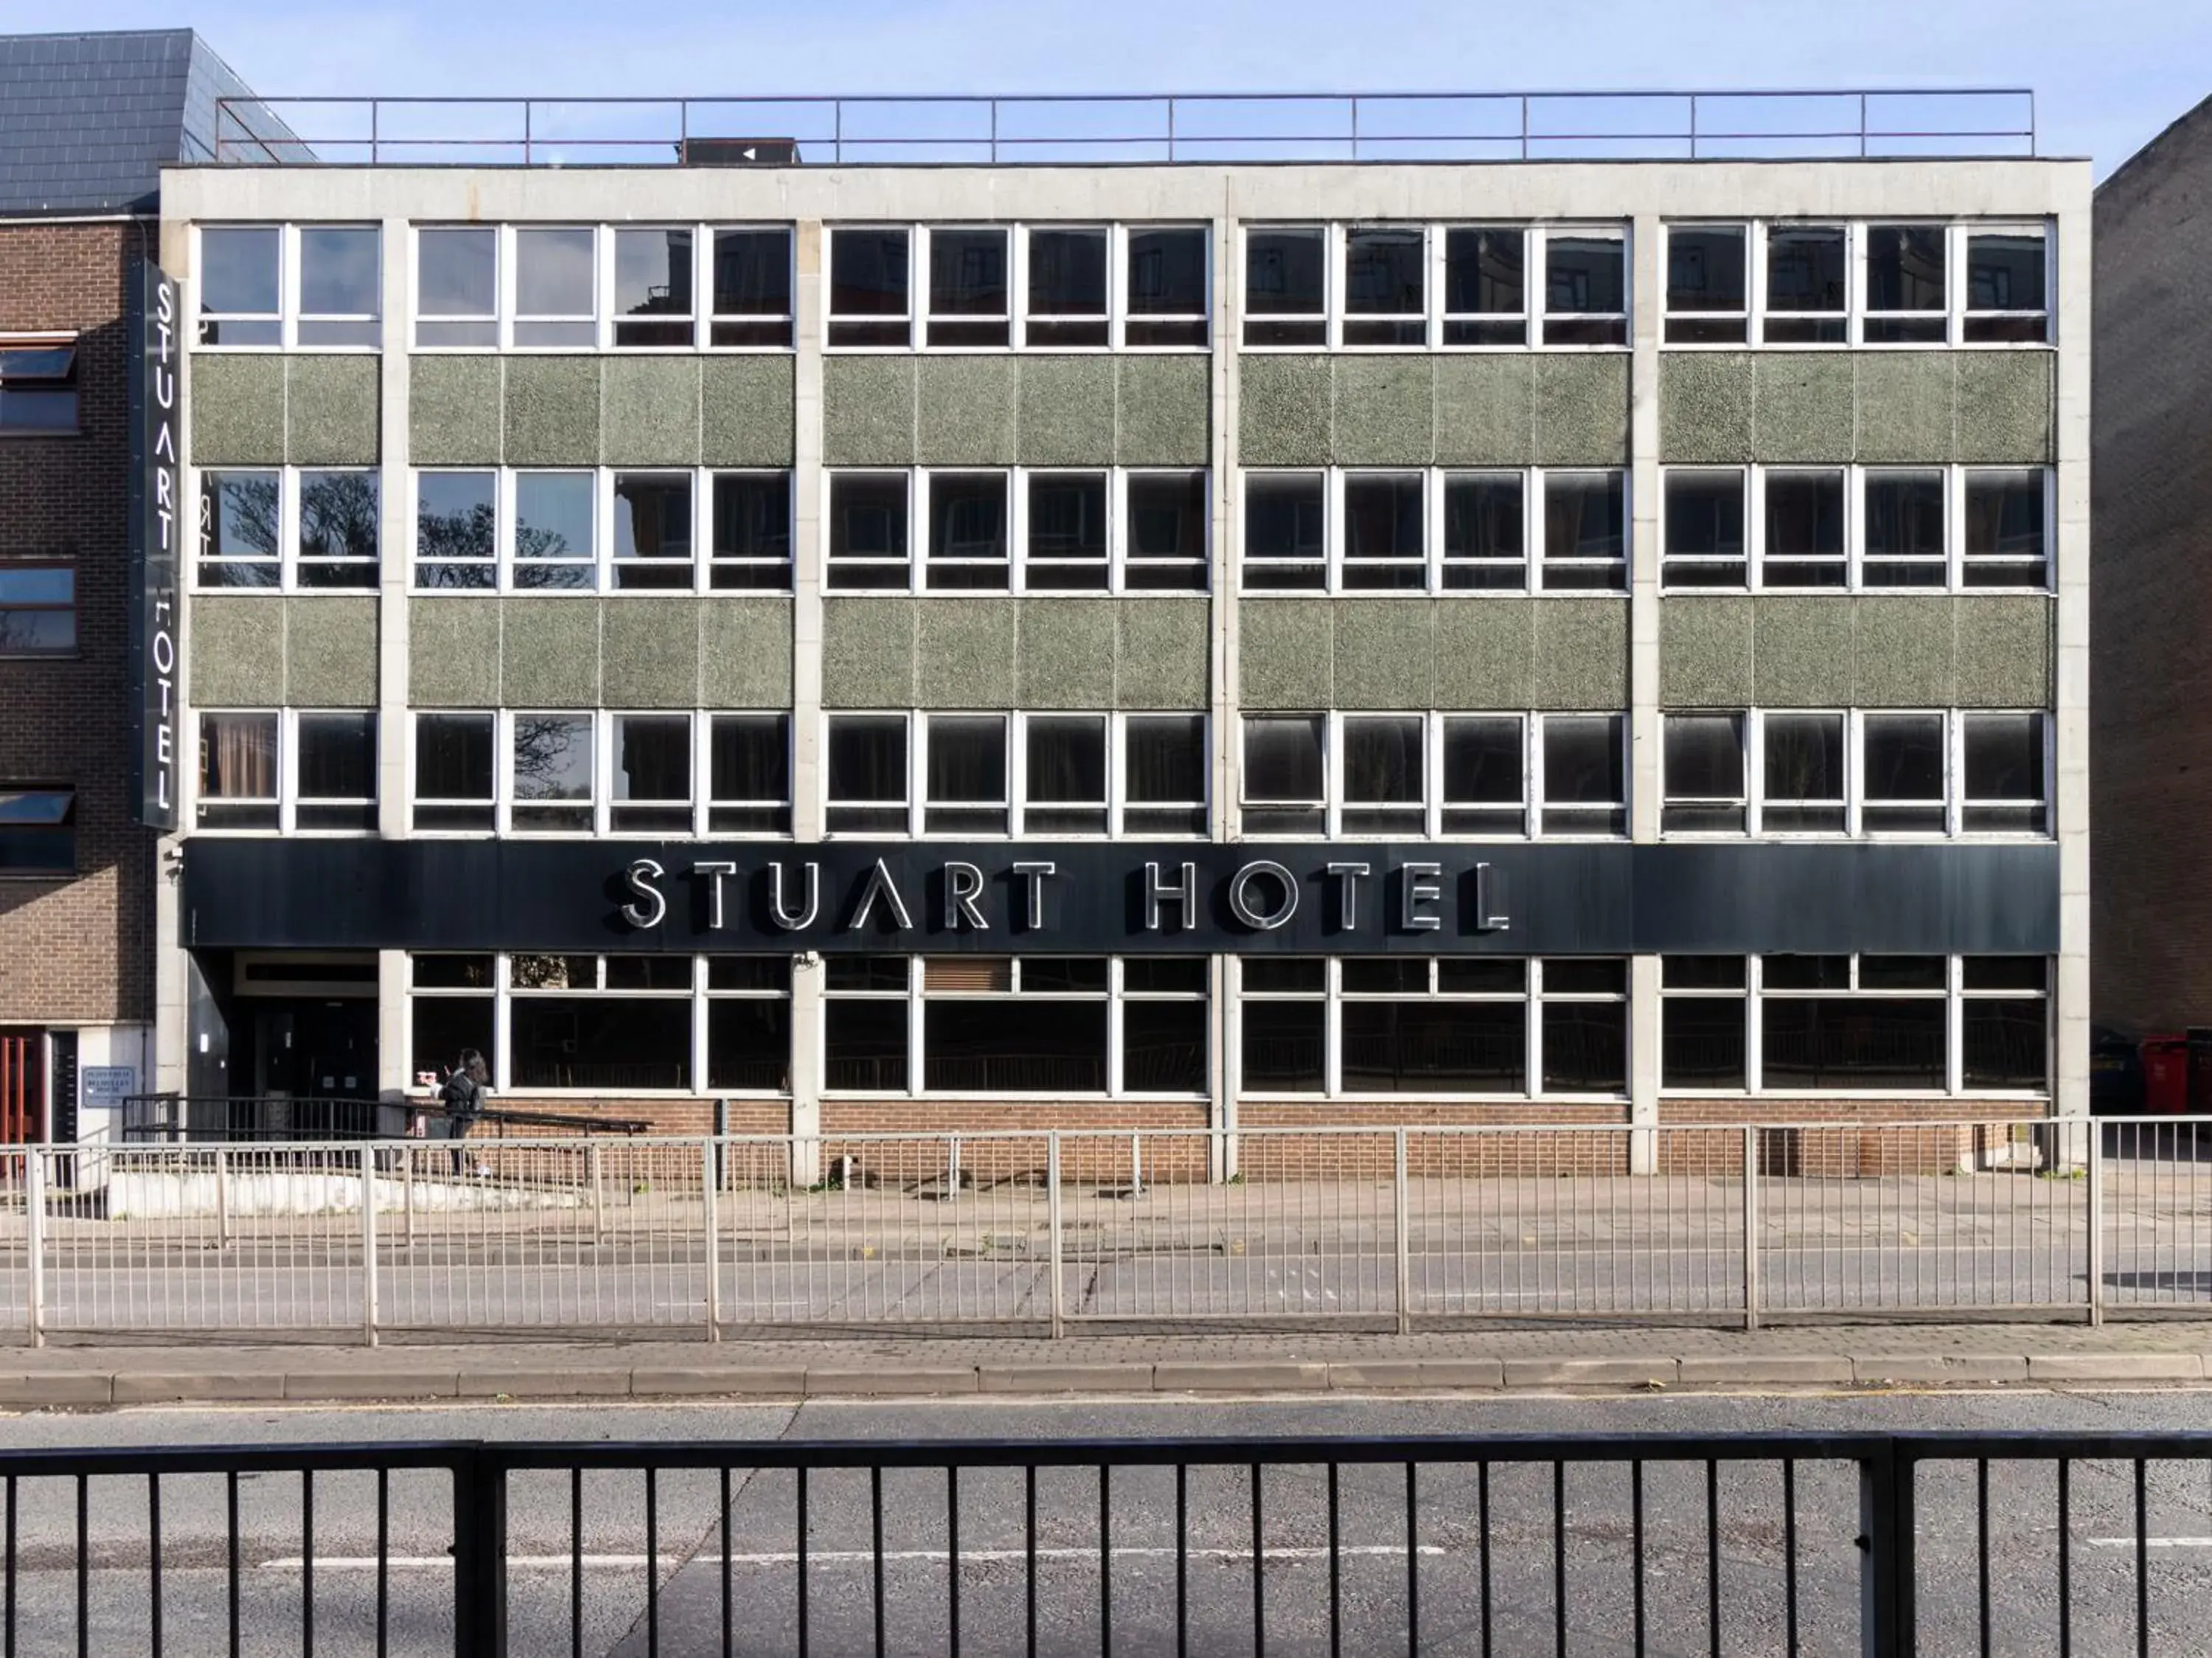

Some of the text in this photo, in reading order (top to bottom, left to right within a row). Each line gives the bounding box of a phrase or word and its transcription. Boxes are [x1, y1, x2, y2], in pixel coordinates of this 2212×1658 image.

[156, 282, 174, 549] STUART
[622, 858, 1509, 930] STUART HOTEL
